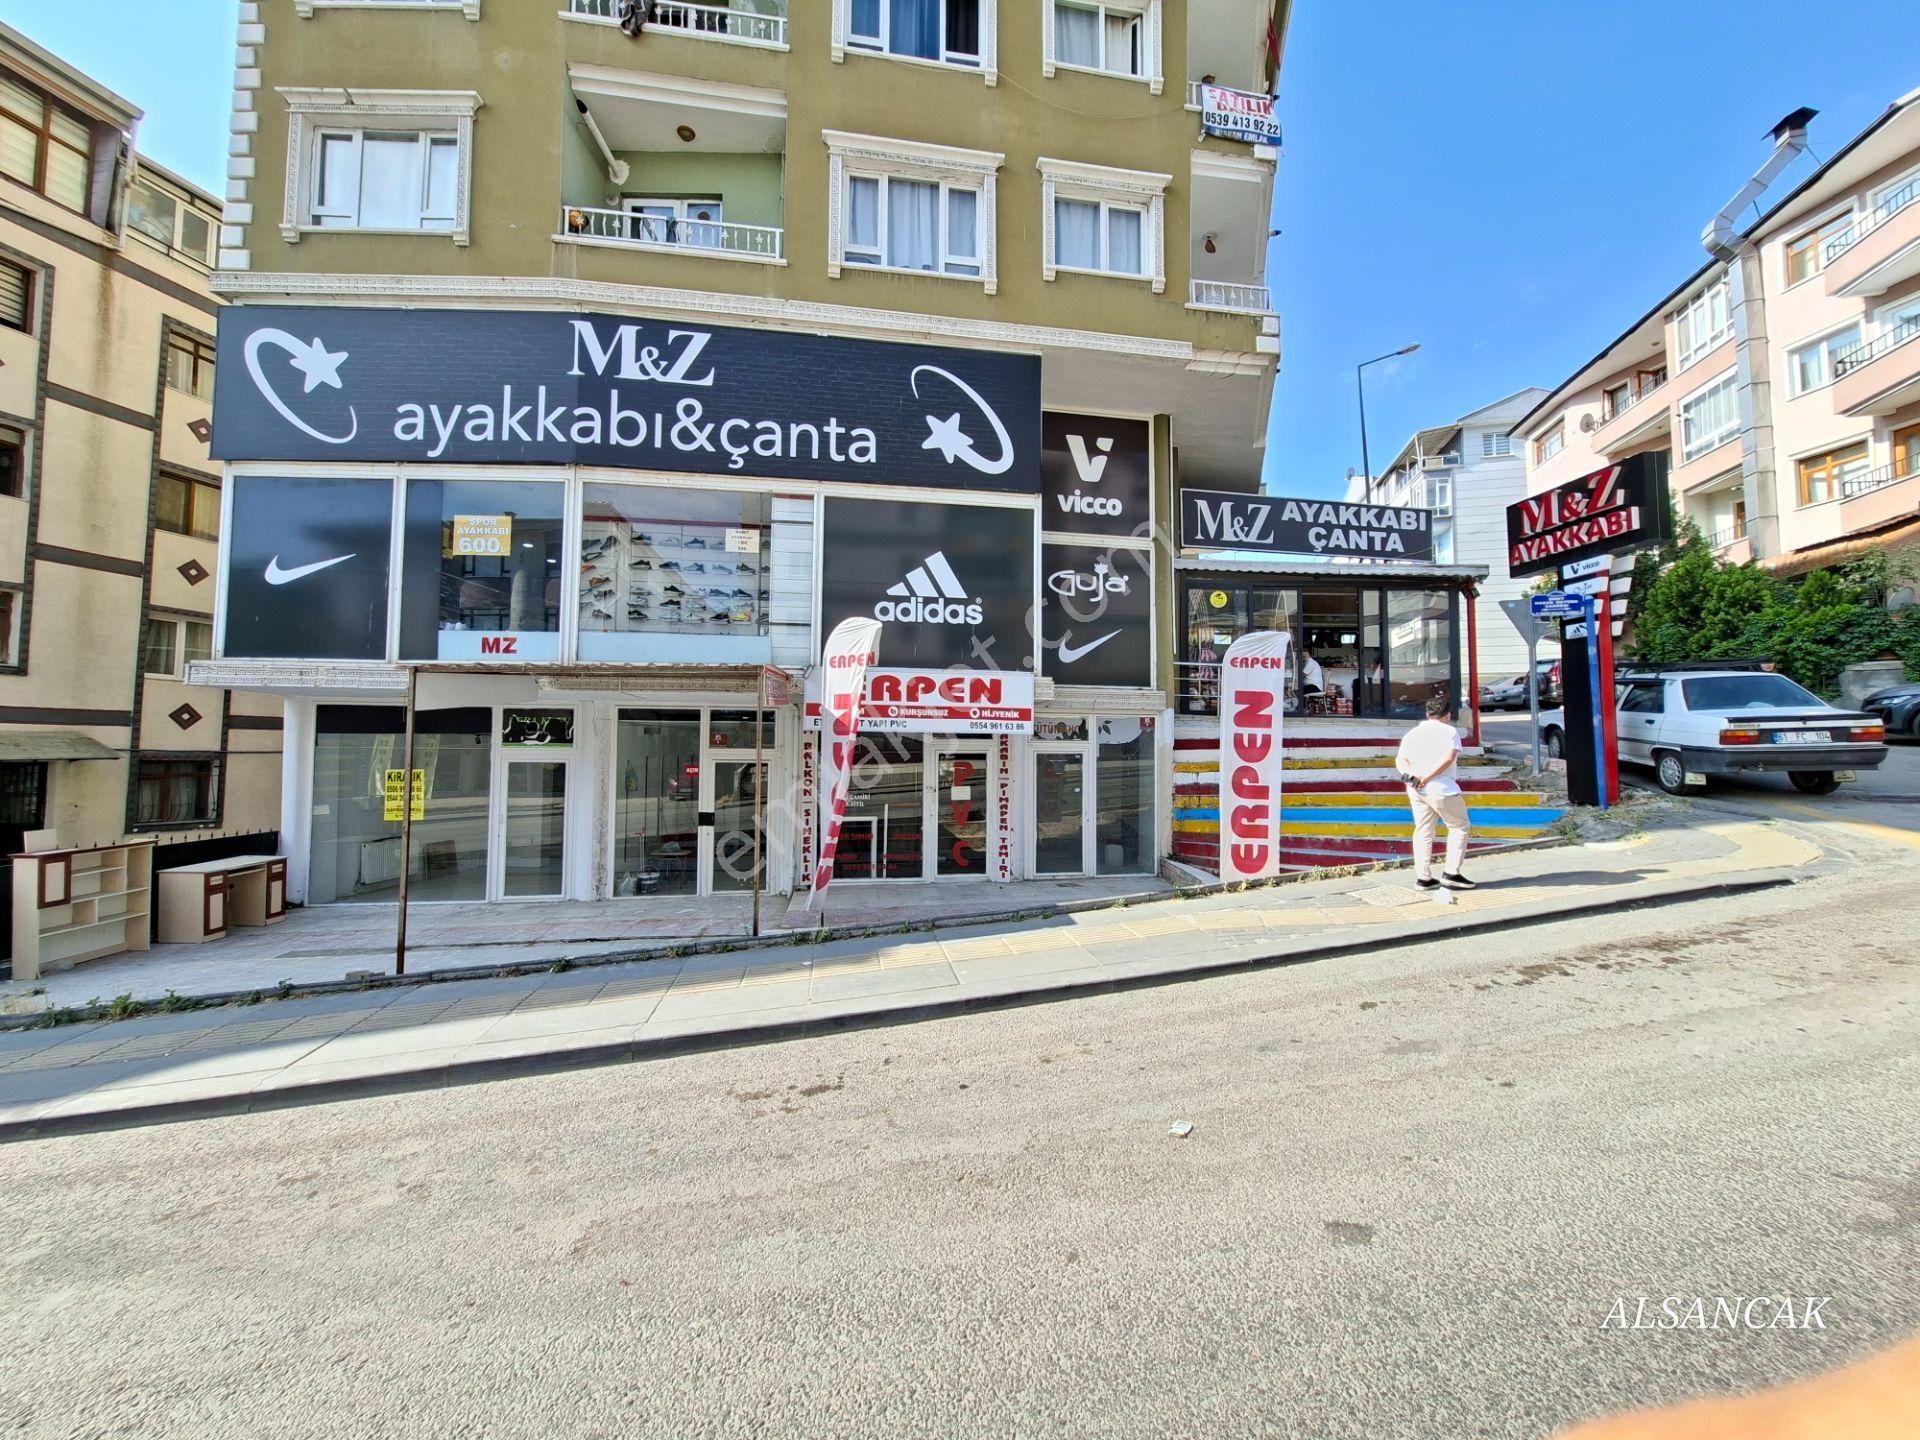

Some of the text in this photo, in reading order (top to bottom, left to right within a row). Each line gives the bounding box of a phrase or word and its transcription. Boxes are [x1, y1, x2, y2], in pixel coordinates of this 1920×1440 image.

[1208, 87, 1273, 115] SATILIK
[1205, 112, 1279, 135] 0539 413 92 22
[1244, 133, 1268, 143] EMLAK
[567, 320, 716, 387] M&Z
[393, 383, 877, 470] ayakkabı&çanta
[1057, 489, 1123, 517] vicco
[1517, 466, 1626, 539] M&Z
[457, 527, 509, 535] AYAKKABI
[1194, 499, 1427, 546] M&Z AYAKKABI
[1308, 526, 1405, 553] ÇANTA
[1510, 506, 1641, 567] AYAKKABI
[874, 597, 983, 625] adidas
[481, 637, 518, 654] MZ
[829, 651, 876, 669] ERPEN
[1229, 656, 1282, 670] ERPEN
[890, 719, 908, 729] PVC
[969, 721, 1025, 731] 0554 961 63 86
[981, 709, 1021, 719] HİJYENİK
[803, 742, 813, 797] BALKON
[1229, 690, 1274, 875] ERPEN
